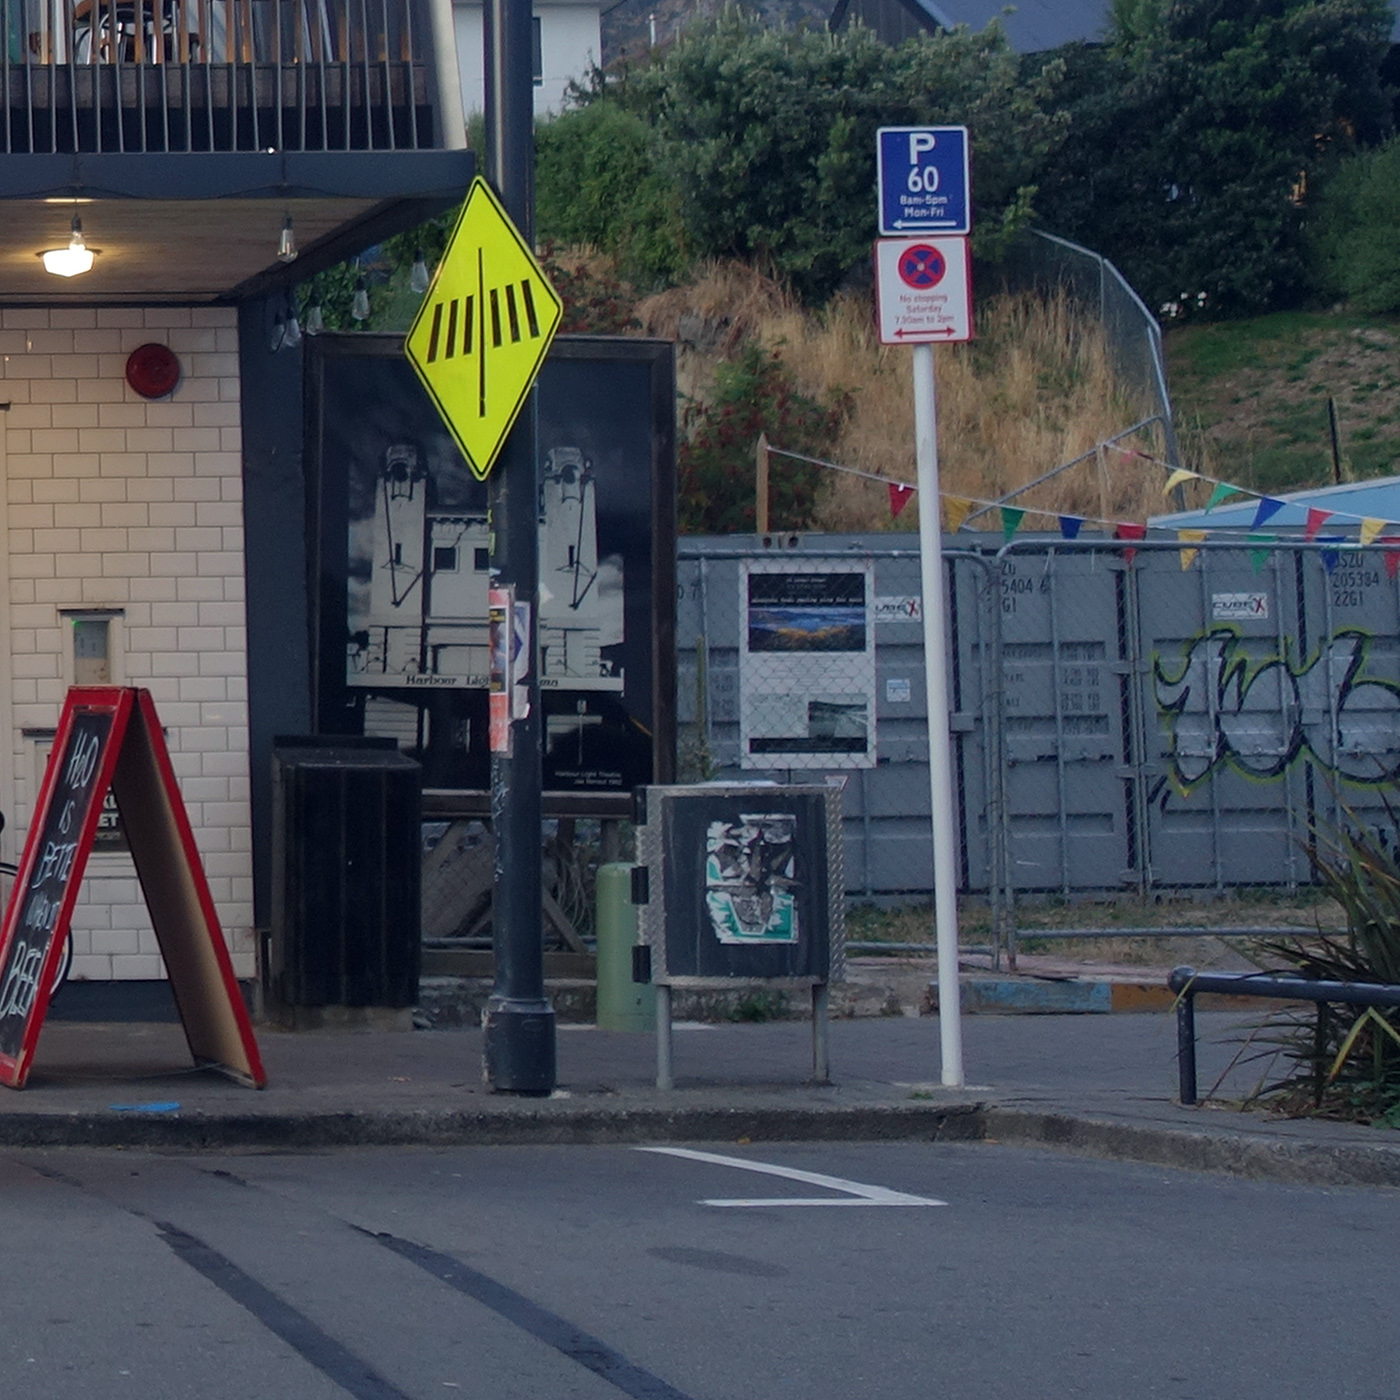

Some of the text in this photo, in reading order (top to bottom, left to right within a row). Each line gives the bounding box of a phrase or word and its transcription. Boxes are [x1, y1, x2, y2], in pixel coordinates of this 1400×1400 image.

[908, 133, 936, 165] P
[907, 165, 939, 193] 60
[903, 207, 945, 218] Mon-Fri
[899, 294, 912, 303] No
[58, 799, 76, 835] IS
[31, 841, 78, 889] BETTE
